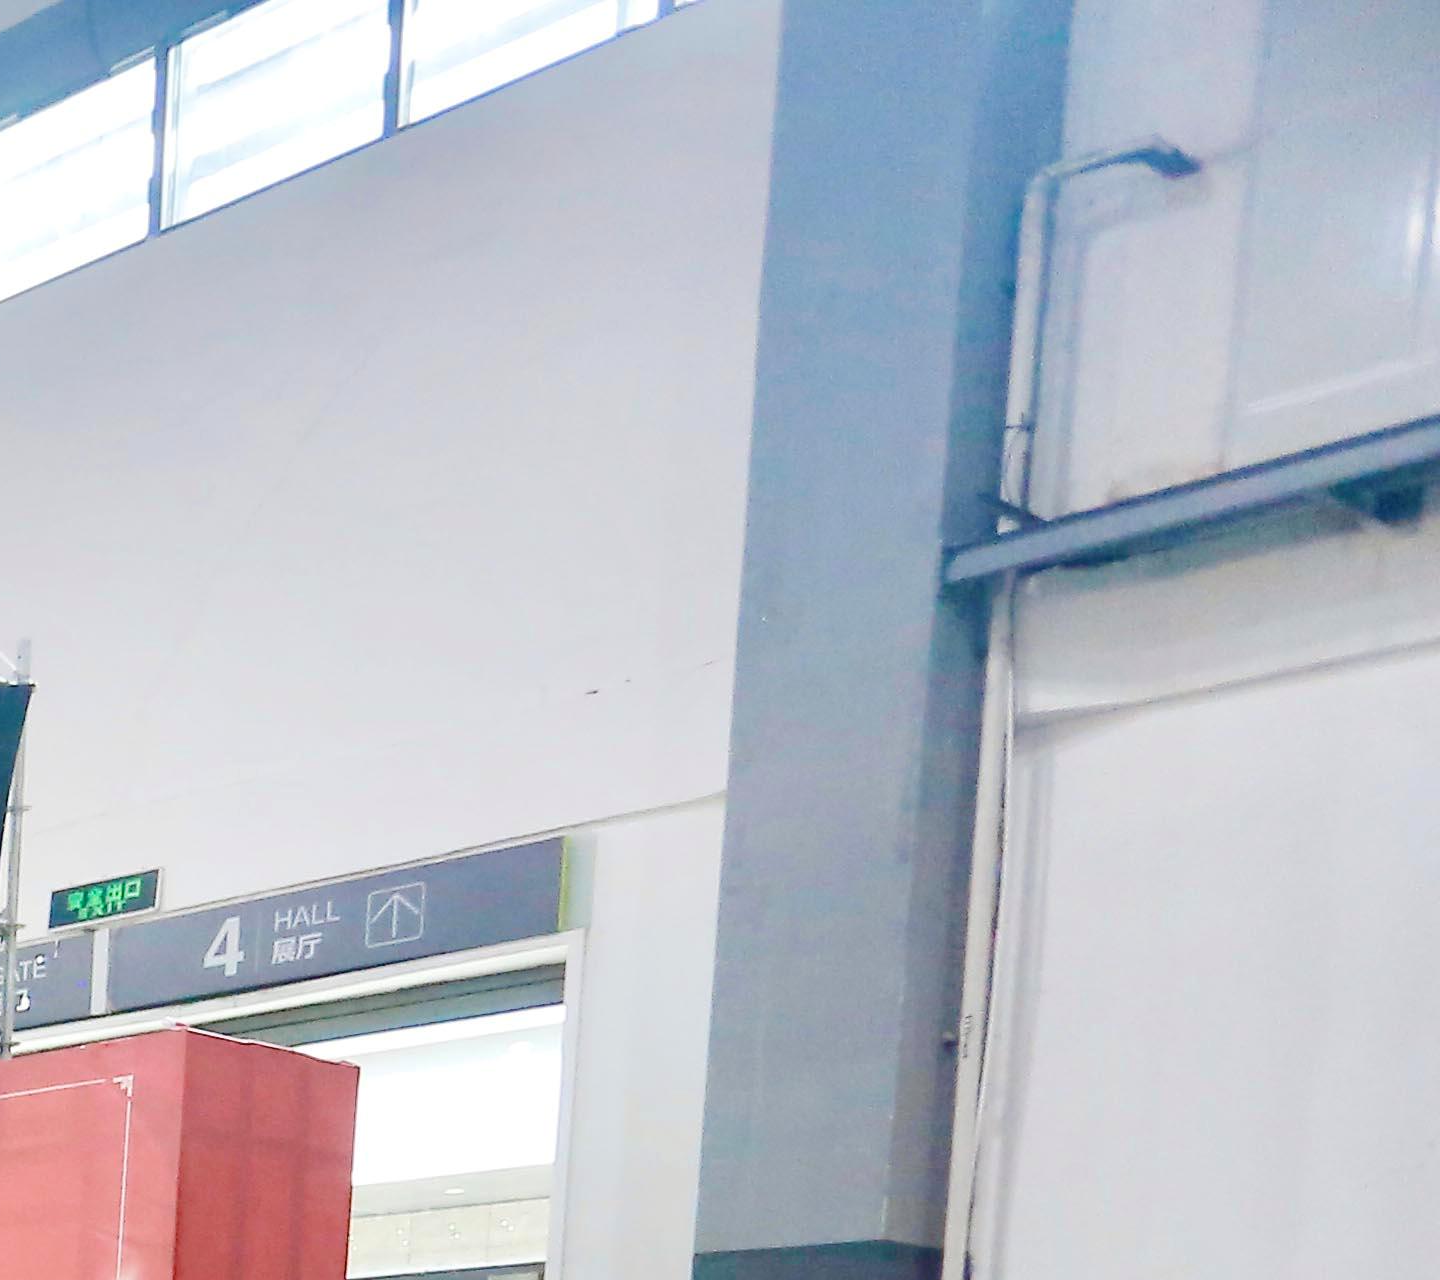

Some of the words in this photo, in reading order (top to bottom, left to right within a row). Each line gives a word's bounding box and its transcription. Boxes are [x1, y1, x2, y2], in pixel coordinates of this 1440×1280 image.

[203, 915, 245, 977] 4
[274, 901, 341, 932] HALL
[271, 932, 323, 965] 展厅
